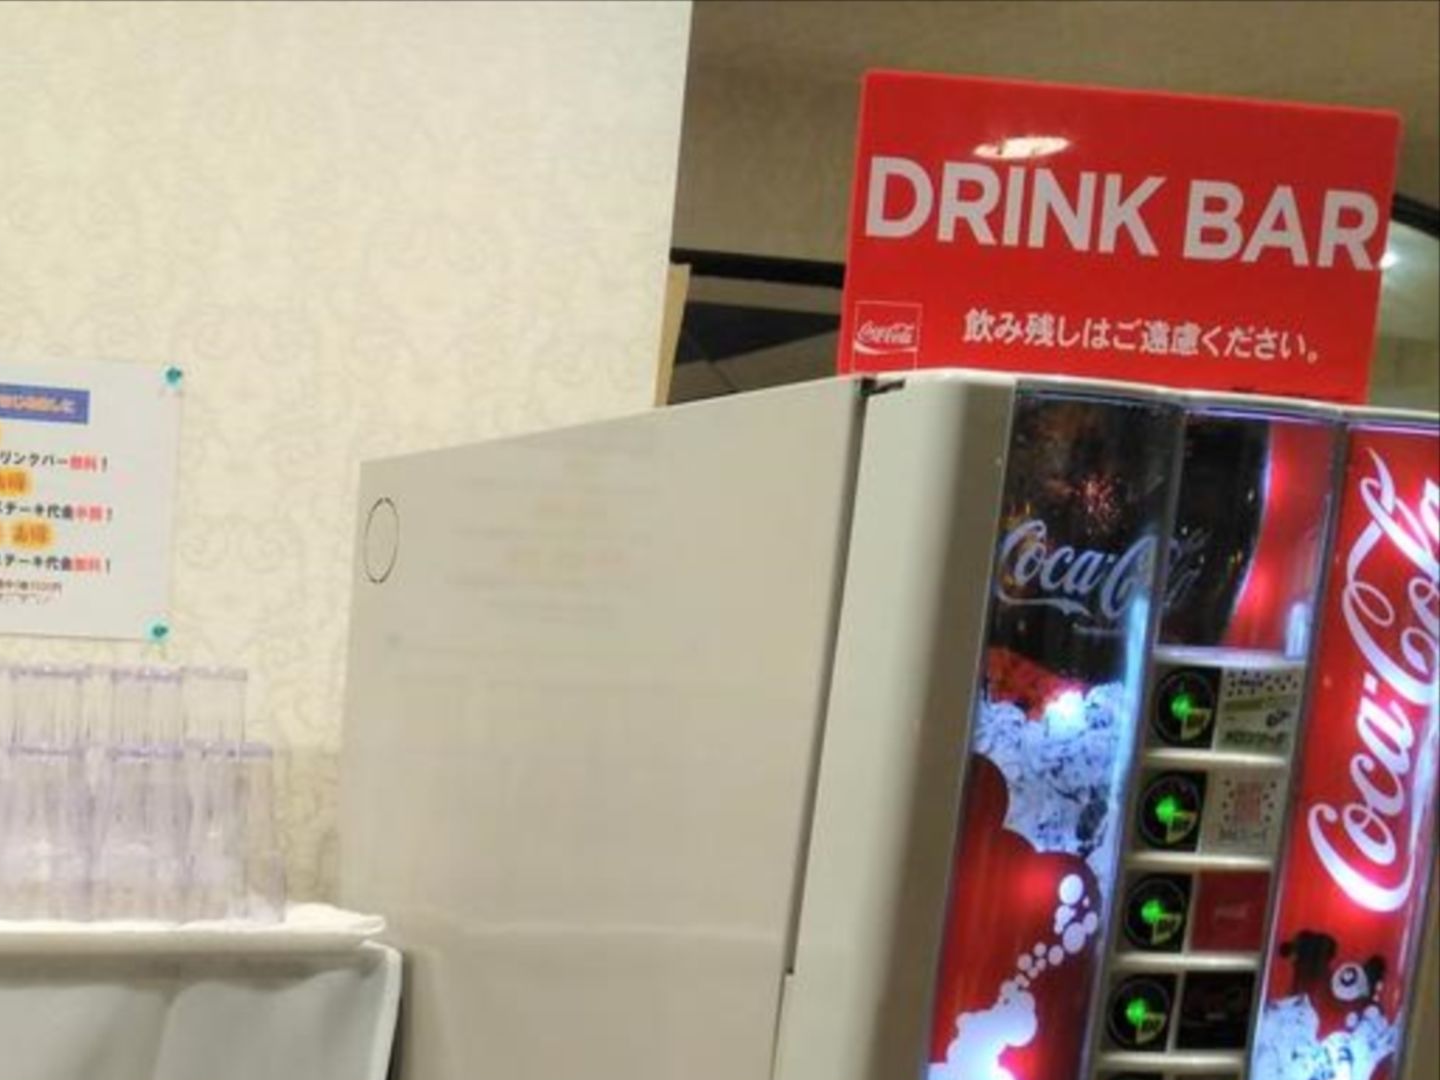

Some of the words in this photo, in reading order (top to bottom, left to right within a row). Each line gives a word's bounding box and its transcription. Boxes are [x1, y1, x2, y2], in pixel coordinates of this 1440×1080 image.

[864, 155, 1166, 258] DRINK
[1182, 179, 1381, 271] BAR
[962, 307, 1319, 365] 飲み残しはご遠慮ください。
